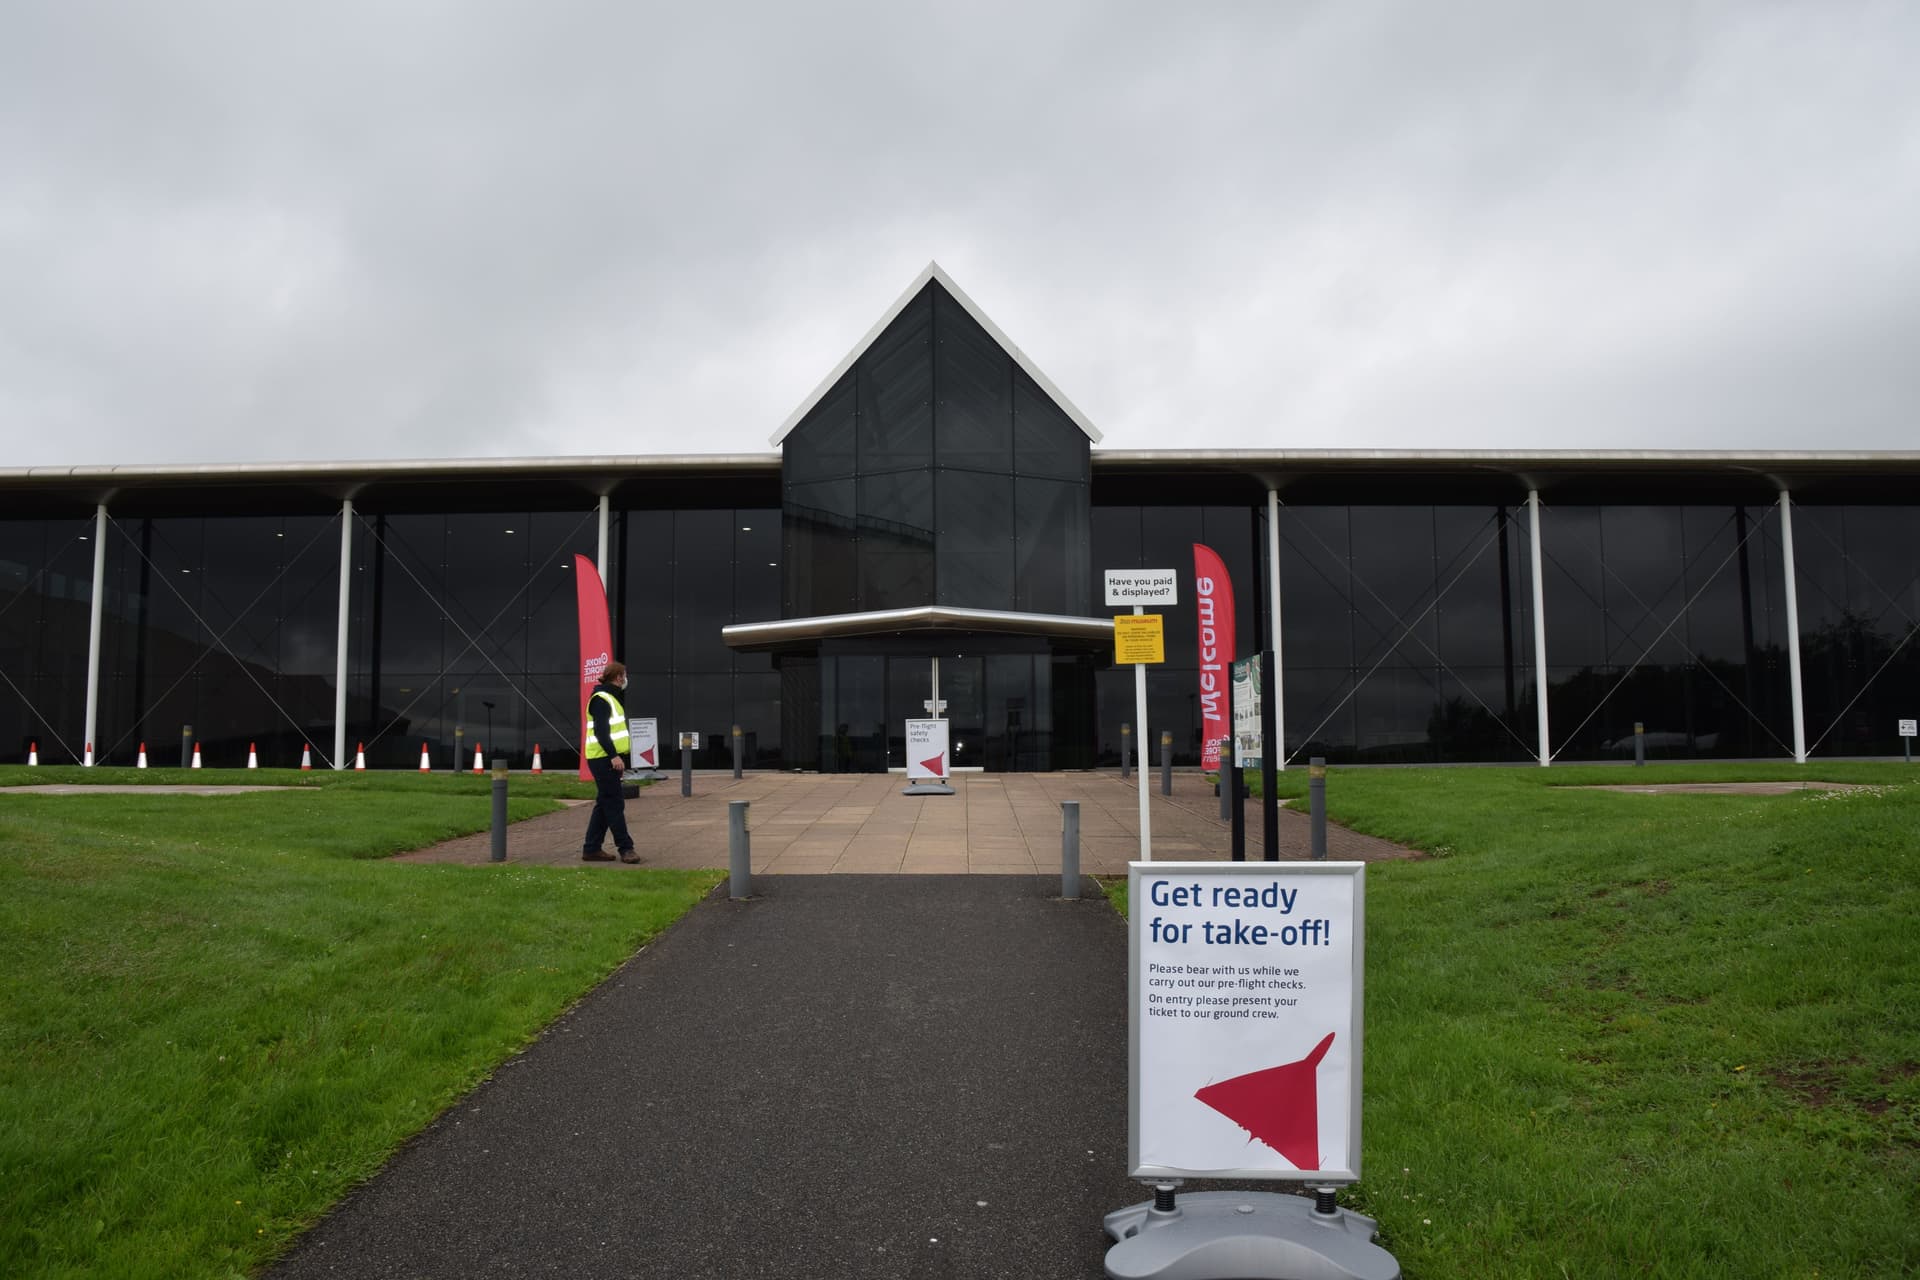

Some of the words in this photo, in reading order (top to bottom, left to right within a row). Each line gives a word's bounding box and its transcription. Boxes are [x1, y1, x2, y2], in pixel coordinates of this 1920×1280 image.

[1135, 579, 1151, 587] you
[1153, 577, 1173, 586] paid
[1112, 588, 1119, 596] &
[1121, 587, 1170, 597] displayed?
[1151, 880, 1203, 907] Get
[1212, 881, 1298, 915] ready
[1149, 916, 1193, 944] for
[1201, 918, 1330, 946] take-off!
[1149, 963, 1184, 973] Please
[1186, 964, 1210, 974] bear
[1212, 965, 1236, 975] with
[1238, 967, 1250, 975] us
[1252, 965, 1281, 976] while
[1283, 968, 1300, 976] we
[1149, 978, 1175, 988] carry
[1177, 979, 1195, 988] out
[1198, 979, 1215, 988] our
[1218, 978, 1266, 990] pre-flight
[1268, 979, 1306, 989] checks.
[1149, 993, 1163, 1003] On
[1165, 995, 1193, 1006] entry
[1196, 995, 1230, 1007] please
[1232, 997, 1271, 1007] present
[1274, 998, 1298, 1008] your
[1149, 1006, 1177, 1017] ticket
[1180, 1009, 1191, 1018] to
[1193, 1010, 1211, 1018] our
[1213, 1008, 1250, 1020] ground
[1251, 1010, 1279, 1019] crew.
